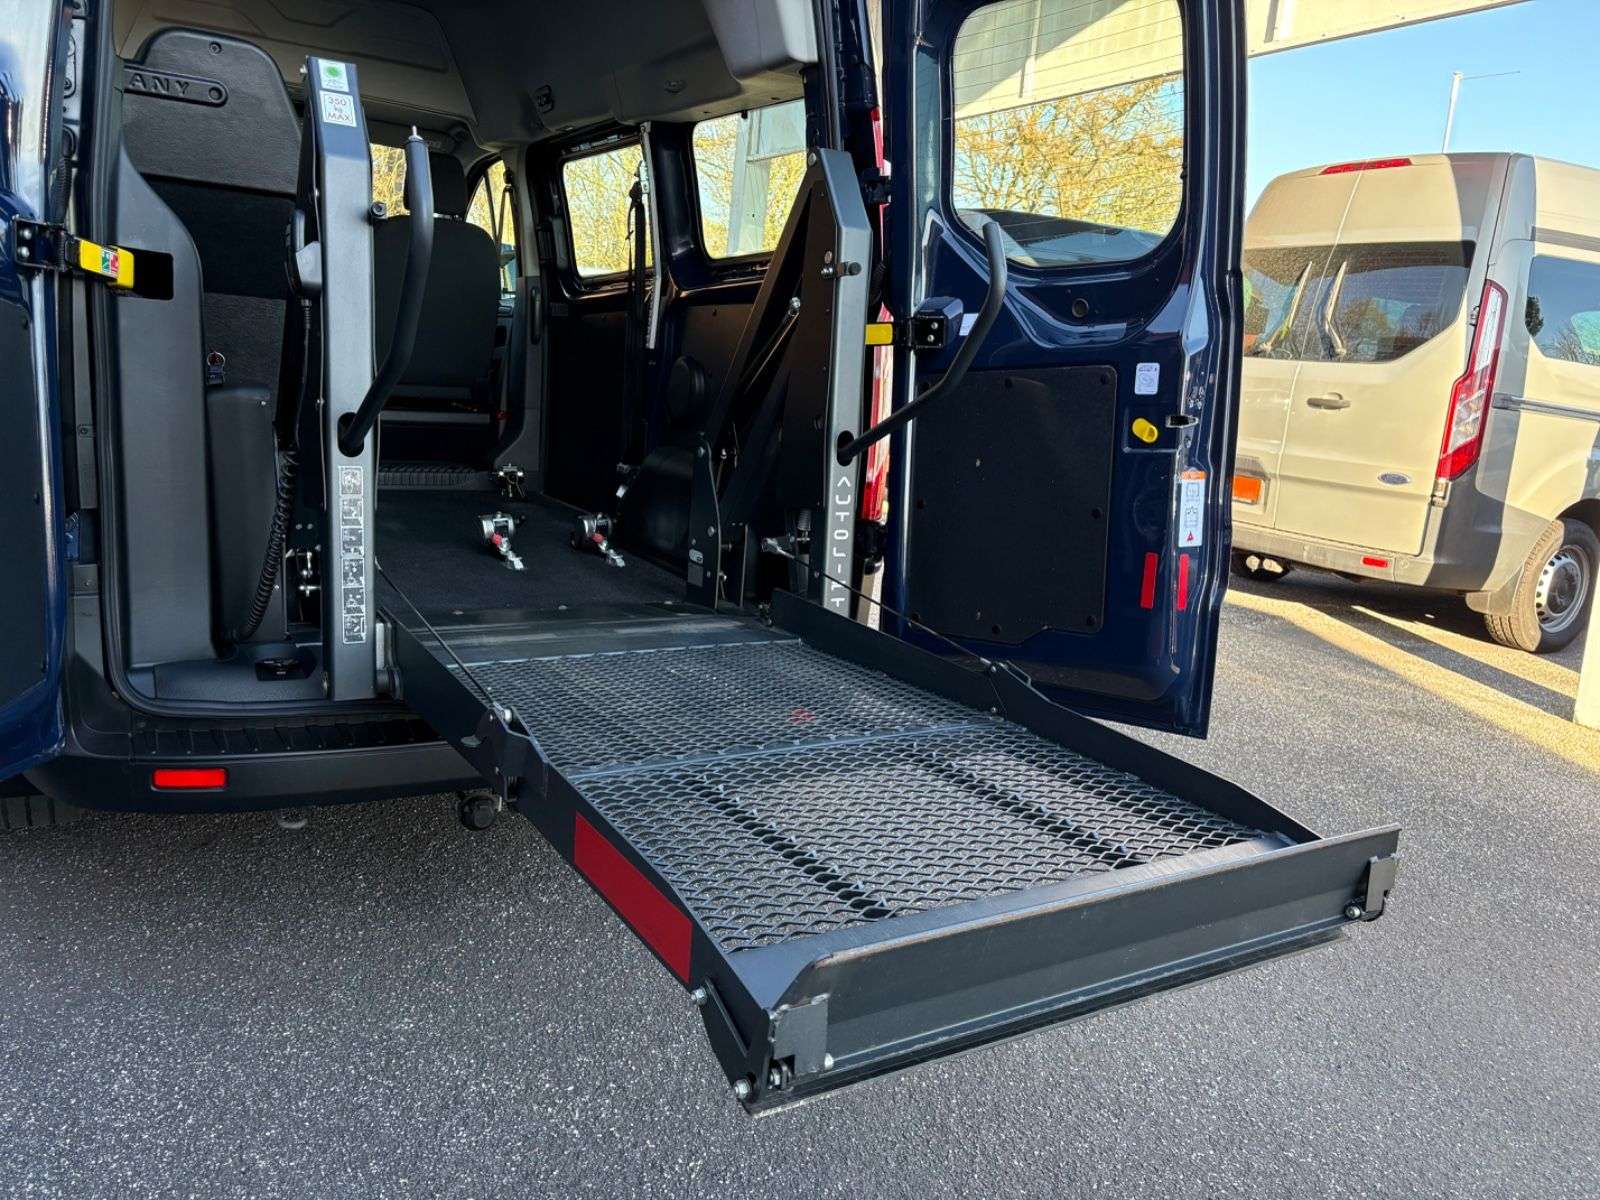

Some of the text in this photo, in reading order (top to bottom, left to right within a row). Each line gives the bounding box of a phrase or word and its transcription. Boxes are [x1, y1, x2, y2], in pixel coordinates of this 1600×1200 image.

[327, 96, 347, 106] 350
[327, 112, 351, 121] MAX
[829, 476, 851, 607] AUTOLIFT
